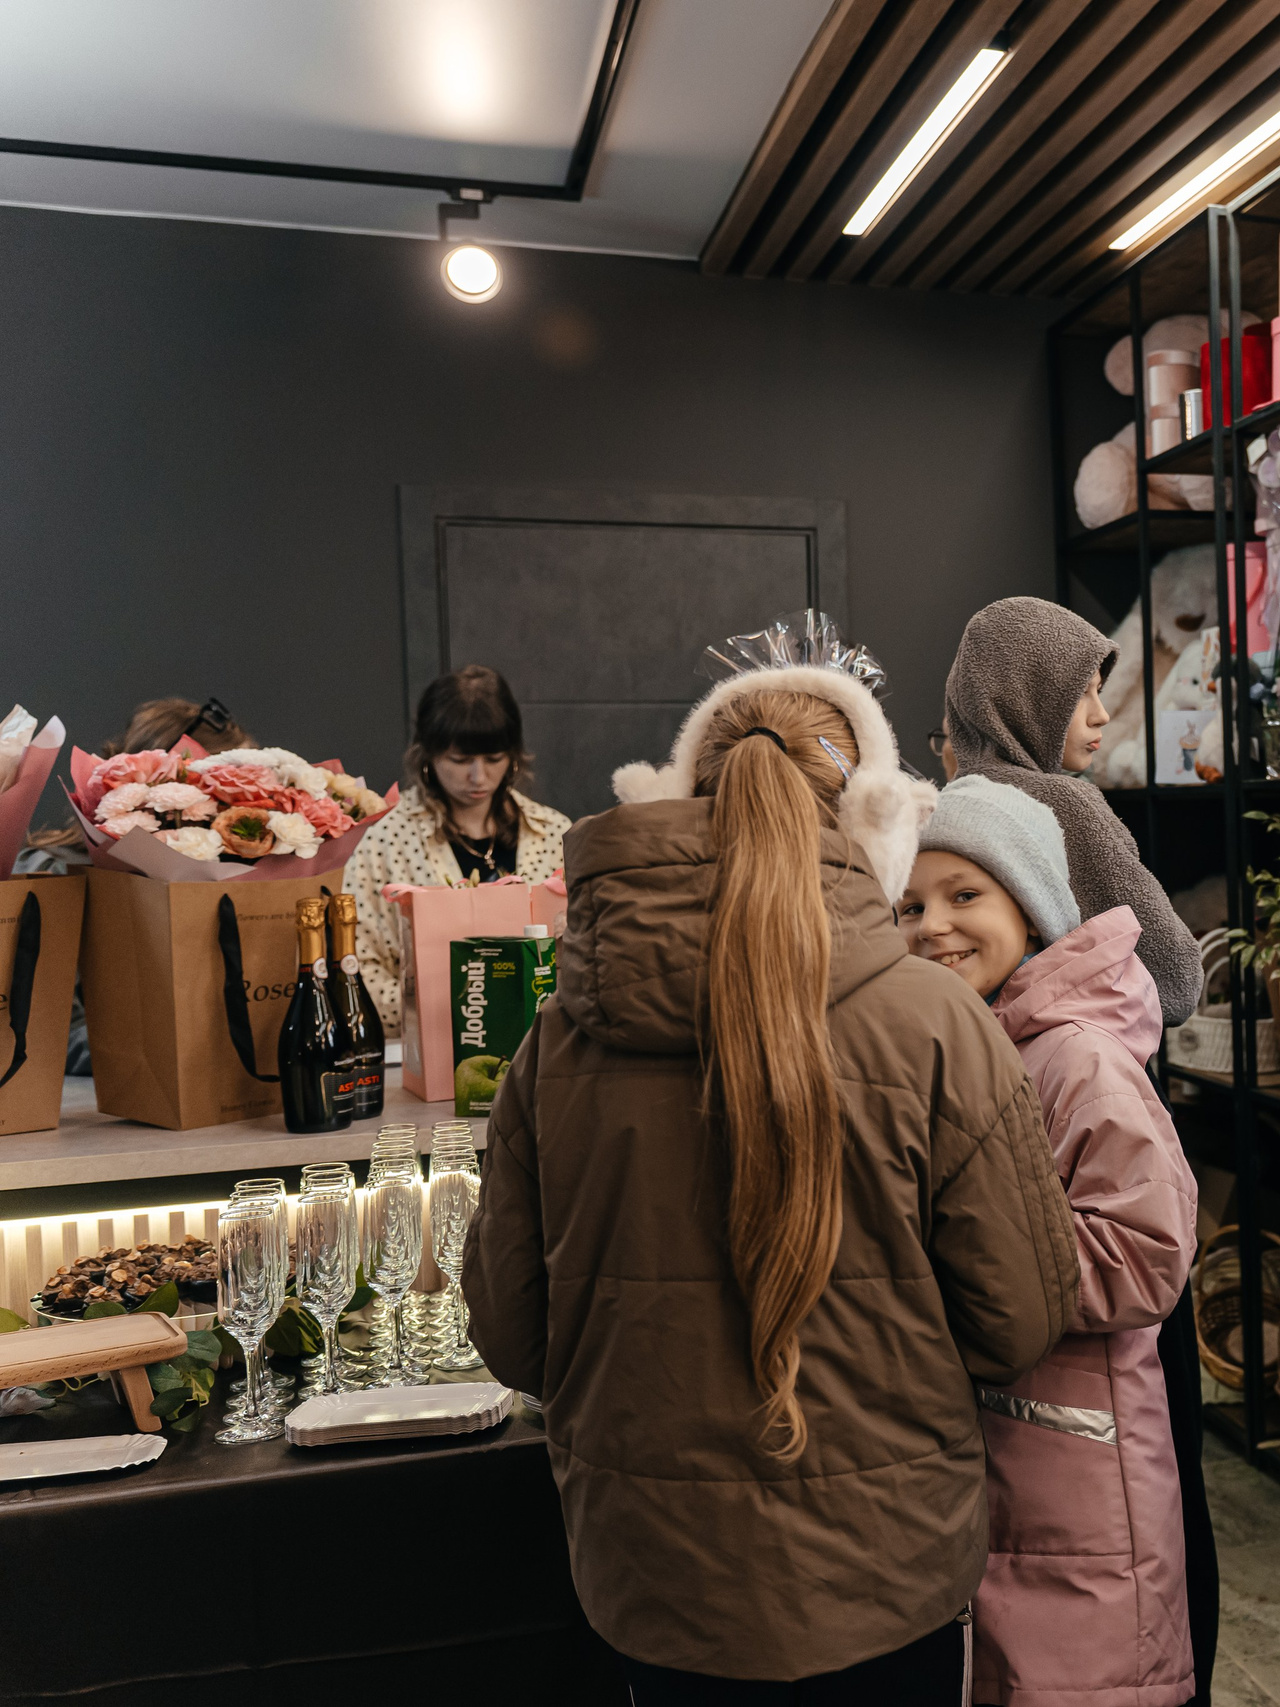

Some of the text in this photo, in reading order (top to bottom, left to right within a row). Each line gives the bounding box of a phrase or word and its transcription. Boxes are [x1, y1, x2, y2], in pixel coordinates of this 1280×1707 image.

[492, 962, 516, 970] 100%
[461, 959, 488, 1048] Добрый
[356, 1075, 380, 1086] ASTI
[338, 1081, 355, 1093] AST
